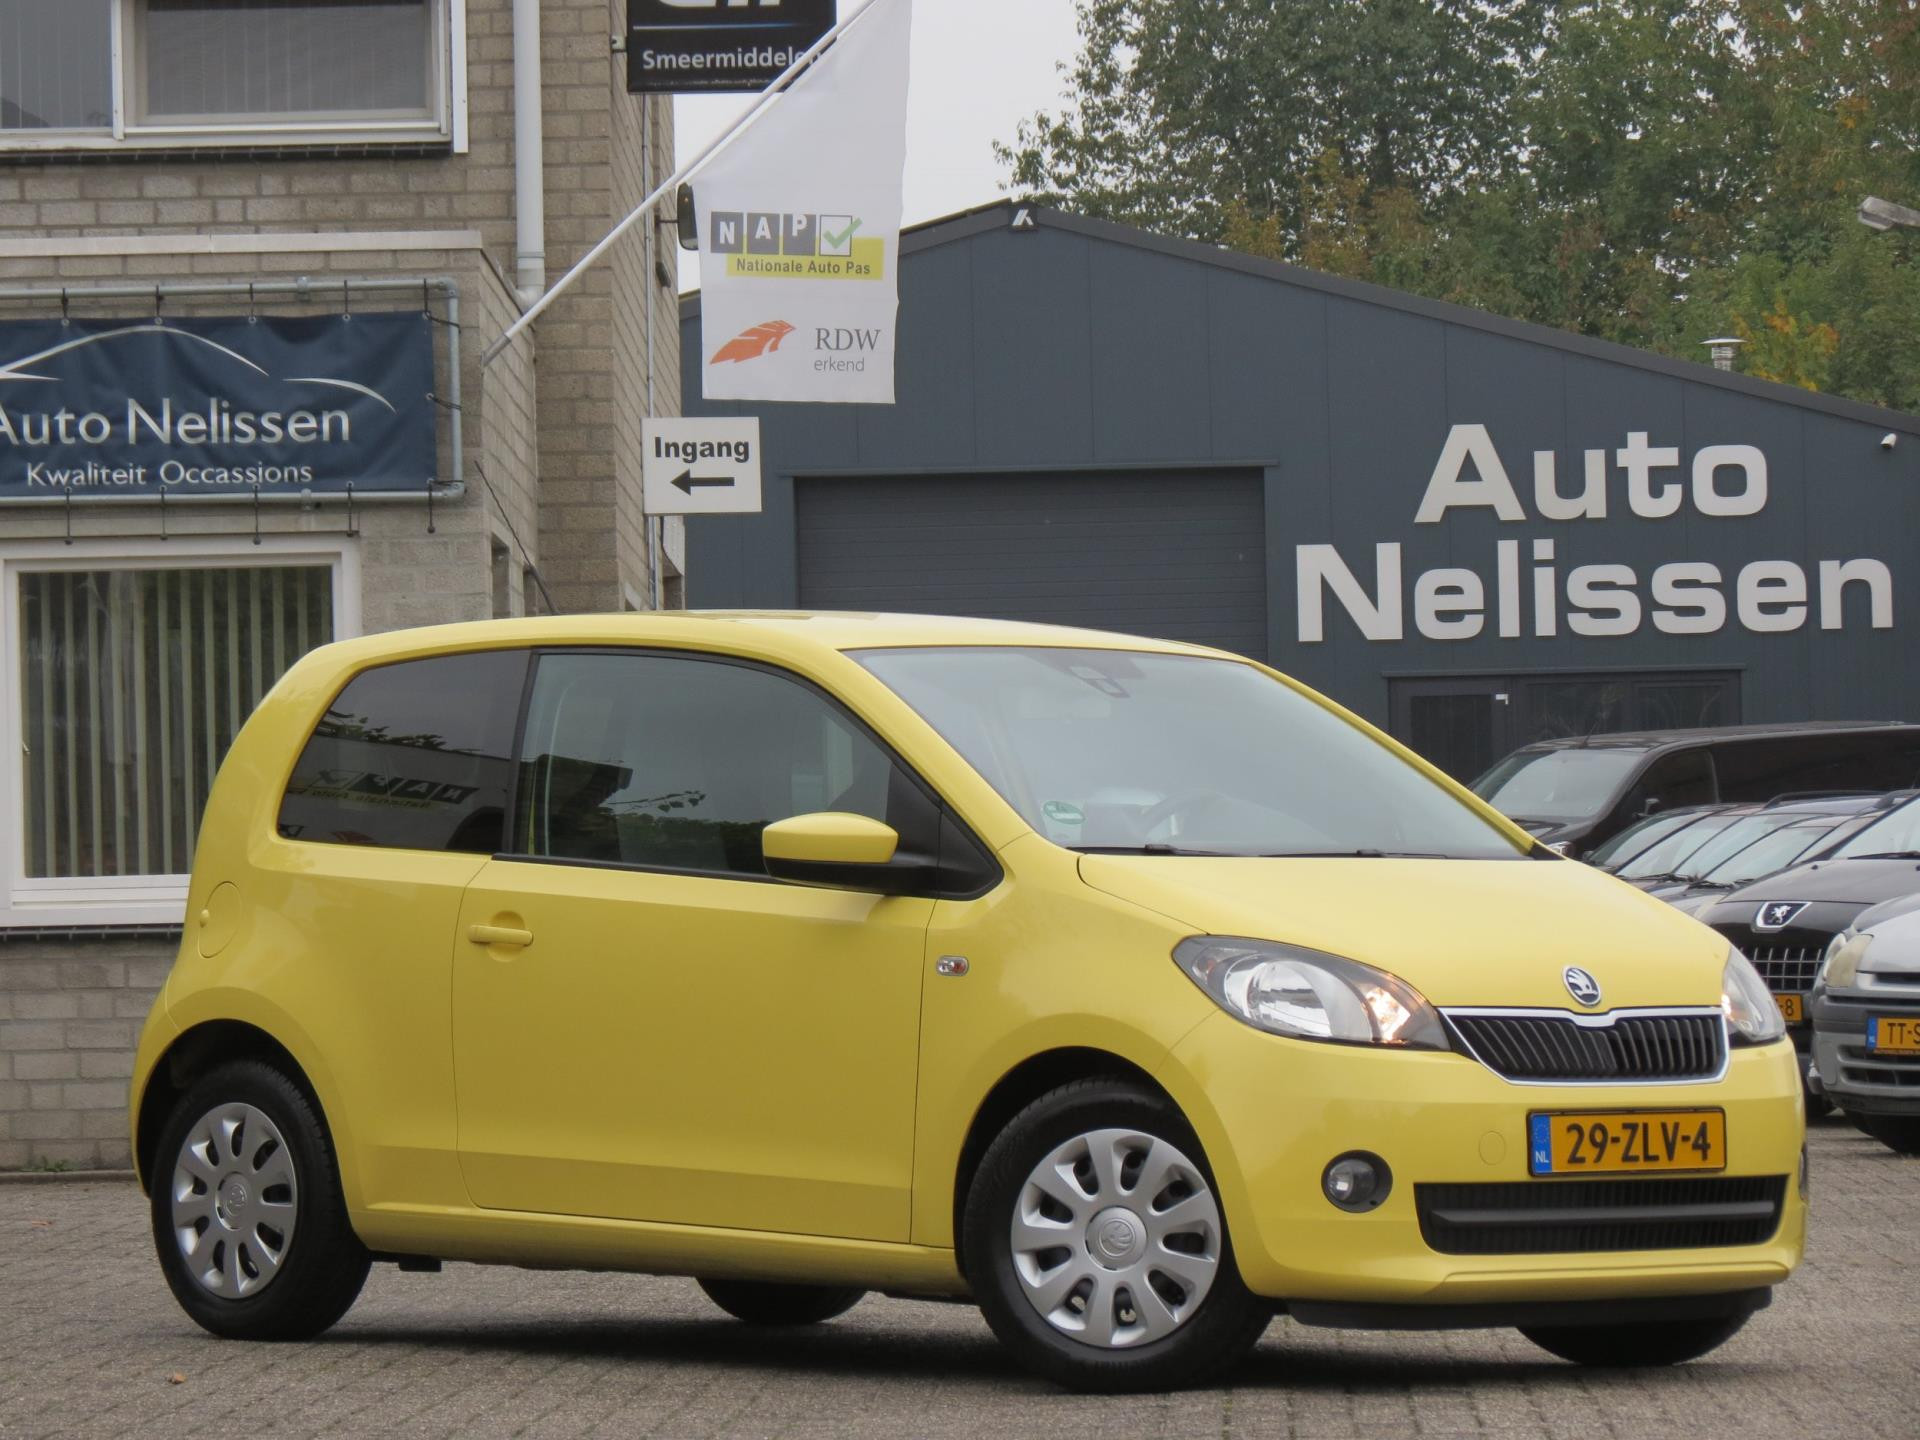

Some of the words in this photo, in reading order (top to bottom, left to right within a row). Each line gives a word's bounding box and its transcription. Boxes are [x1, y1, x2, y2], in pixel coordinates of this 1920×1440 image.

[719, 214, 808, 245] NAP
[736, 257, 803, 273] Nationale
[807, 260, 840, 275] Auto
[845, 260, 871, 275] Pas
[815, 327, 882, 351] RDW
[813, 356, 865, 372] erkend
[127, 397, 350, 445] Nelissen
[654, 436, 750, 464] Ingang
[26, 460, 147, 487] Kwaliteit
[159, 459, 313, 485] Occassions
[1413, 423, 1768, 523] Auto
[1296, 538, 1894, 642] Nelissen
[1535, 1150, 1550, 1164] NL
[1566, 1121, 1711, 1164] 29-ZLV-4
